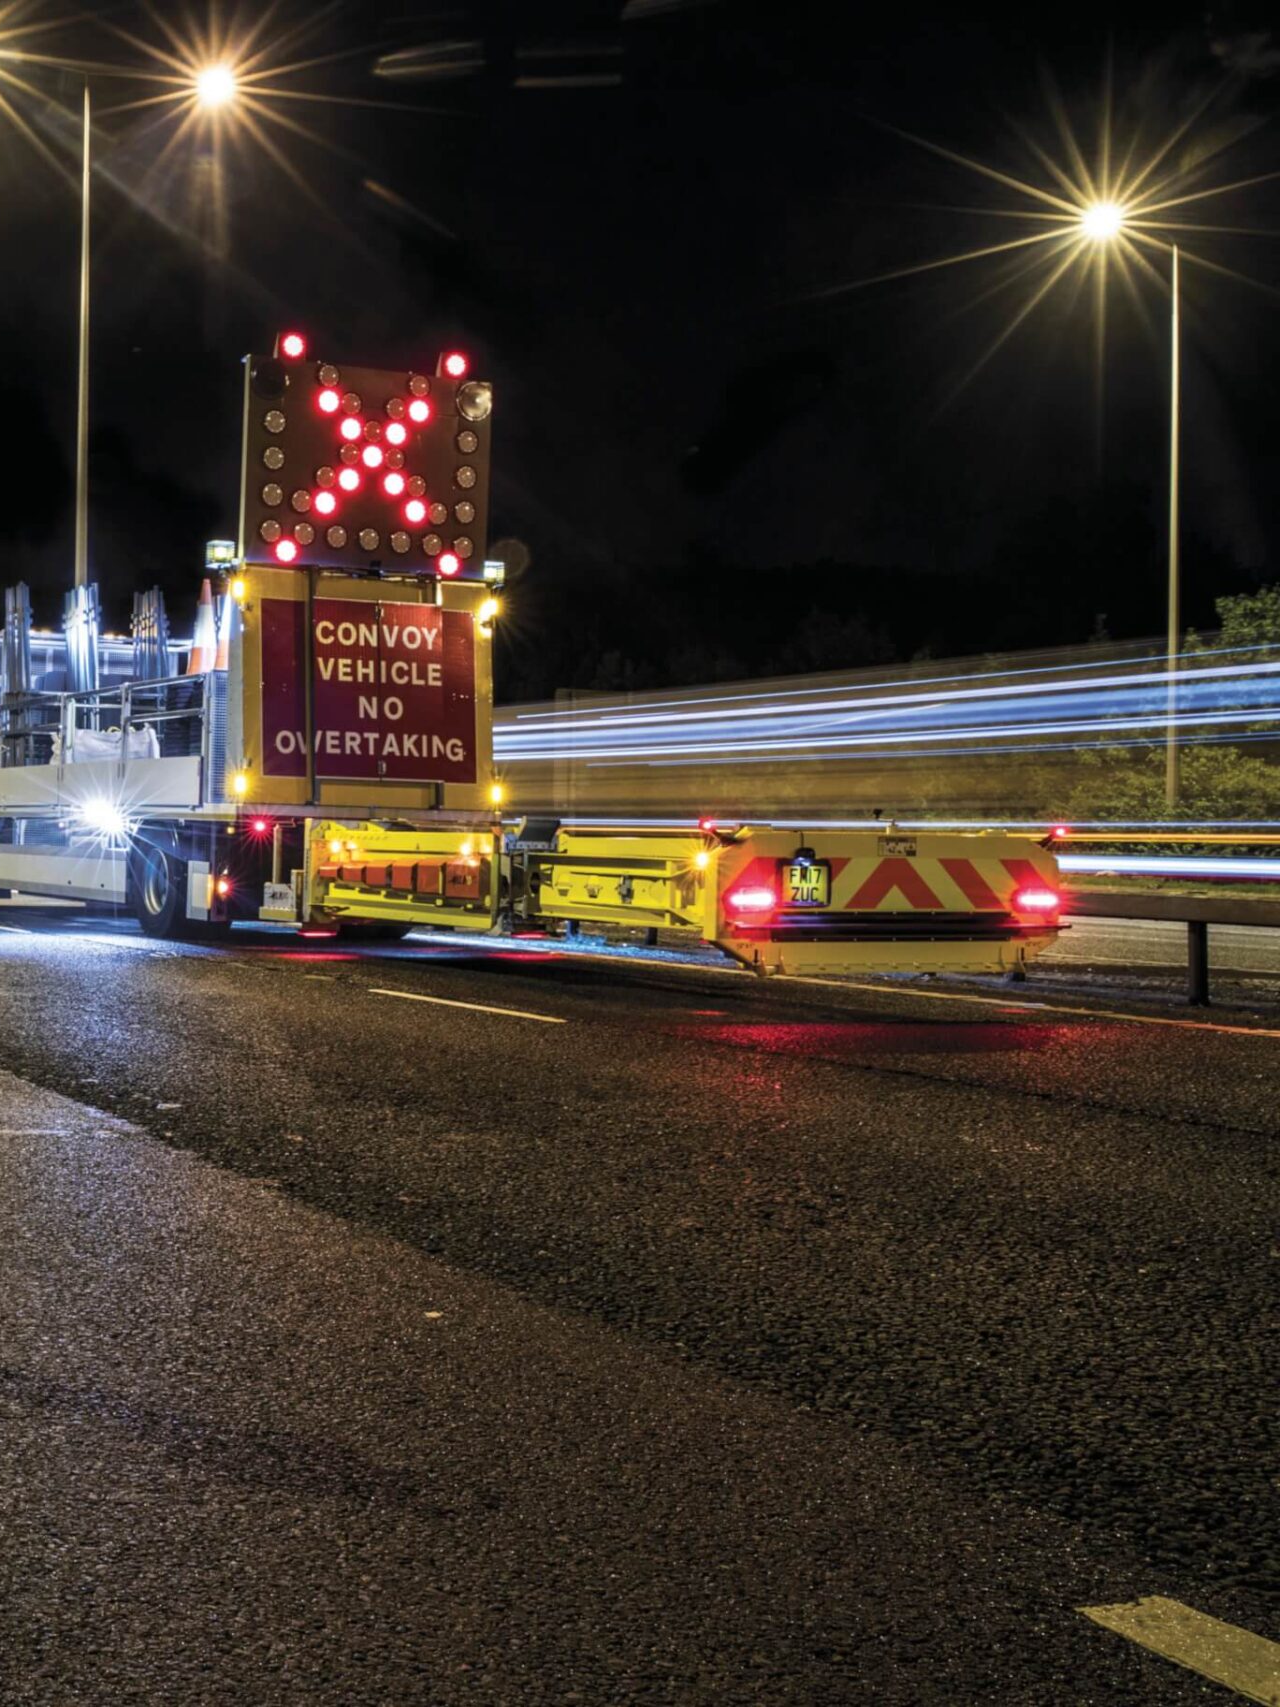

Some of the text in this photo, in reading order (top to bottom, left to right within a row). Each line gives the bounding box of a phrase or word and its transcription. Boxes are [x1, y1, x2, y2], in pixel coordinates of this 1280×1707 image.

[316, 620, 438, 650] CONVOY
[317, 657, 442, 686] VEHICLE
[359, 695, 403, 720] NO
[275, 730, 464, 762] OVERTAKING
[791, 886, 819, 902] ZUC
